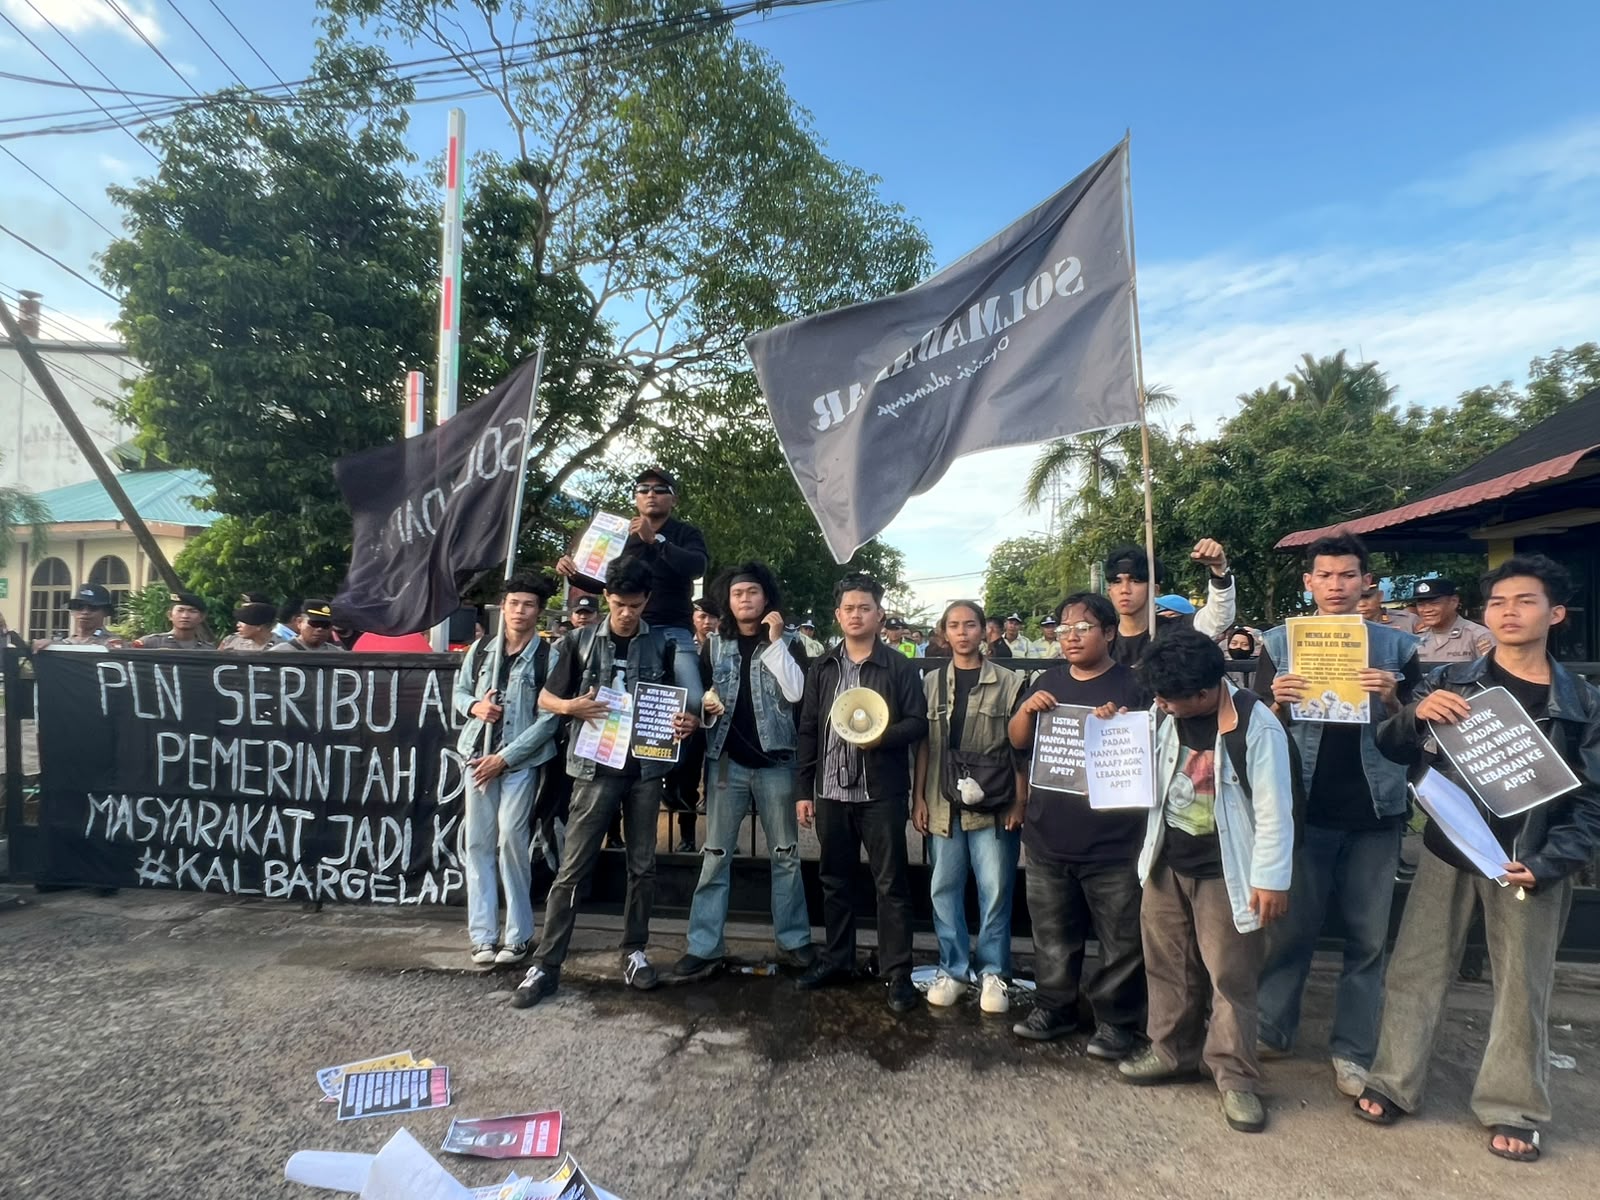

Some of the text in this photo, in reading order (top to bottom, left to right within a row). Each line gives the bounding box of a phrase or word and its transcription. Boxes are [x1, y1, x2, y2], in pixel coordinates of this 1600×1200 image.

[1304, 640, 1323, 648] TANAH
[96, 661, 182, 721] PLN
[213, 664, 398, 733] SERIBU
[1052, 717, 1079, 727] LISTRIK
[1457, 708, 1497, 733] LISTRIK
[1052, 727, 1079, 737] PADAM
[1101, 727, 1130, 737] LISTRIK
[1465, 720, 1505, 745] PADAM
[1039, 735, 1085, 748] HANYA MINT
[1102, 737, 1131, 746] PADAM
[1456, 723, 1532, 764] HANYA MINTA
[1040, 744, 1067, 755] MAAF?
[1090, 746, 1144, 759] HANYA MINTA
[1467, 736, 1537, 774] MAAF? AGIK
[1040, 754, 1076, 767] LEBARAN
[1094, 757, 1142, 768] MAAF? AGIK
[1476, 748, 1545, 786] LEBARAN KE
[156, 732, 416, 804] PEMERINTAH
[1050, 766, 1075, 777] APE??
[1096, 767, 1143, 779] LEBARAN KE
[1504, 768, 1537, 791] APE??
[85, 793, 315, 863] MASYARAKAT
[321, 814, 413, 868] JADI
